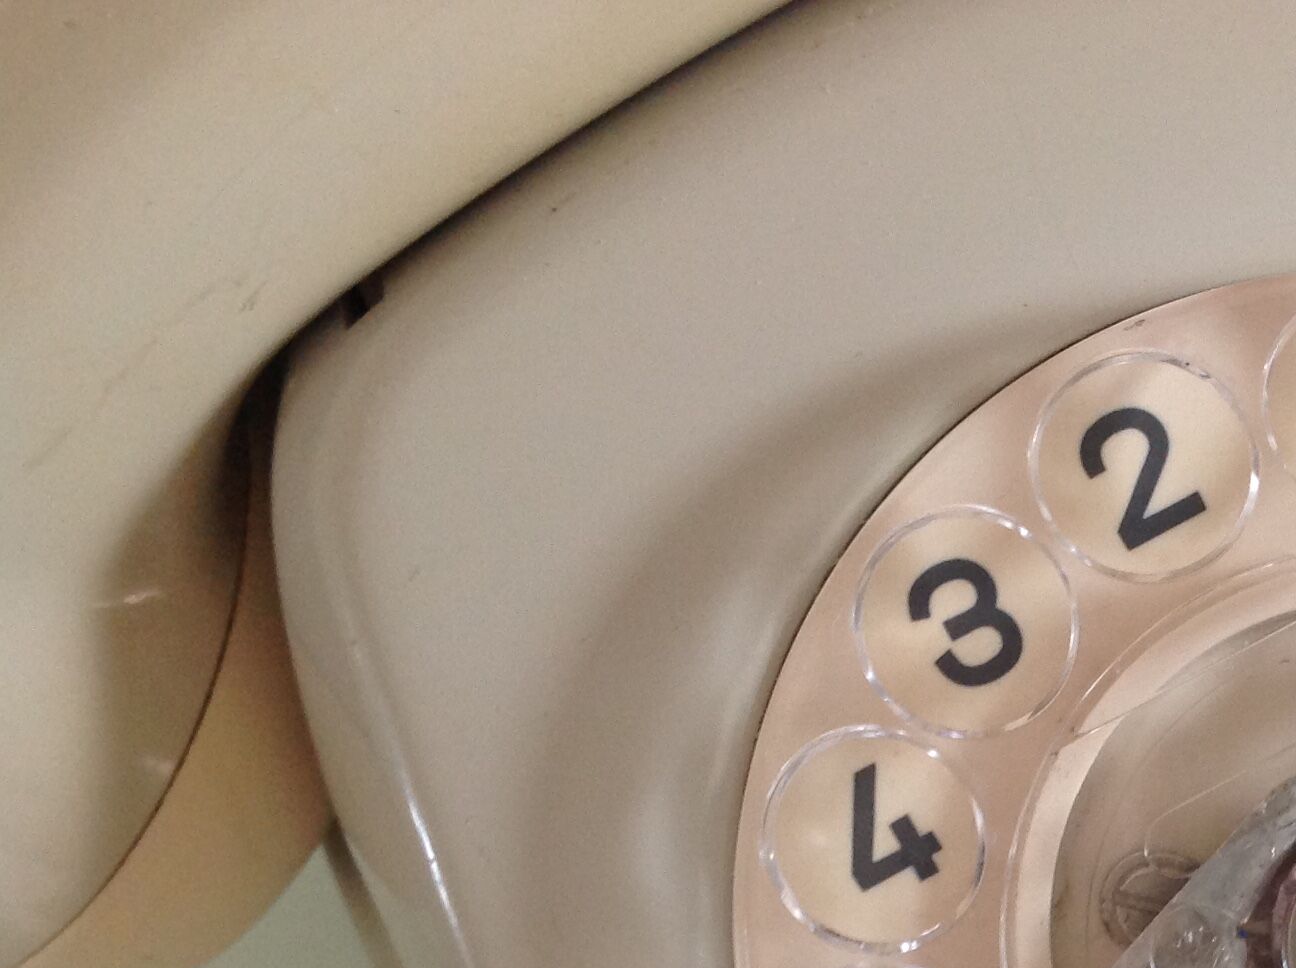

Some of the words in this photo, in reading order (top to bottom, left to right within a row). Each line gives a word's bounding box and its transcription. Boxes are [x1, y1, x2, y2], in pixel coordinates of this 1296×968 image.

[1079, 407, 1207, 551] 2
[907, 558, 1024, 688] 3
[851, 762, 943, 891] 4
